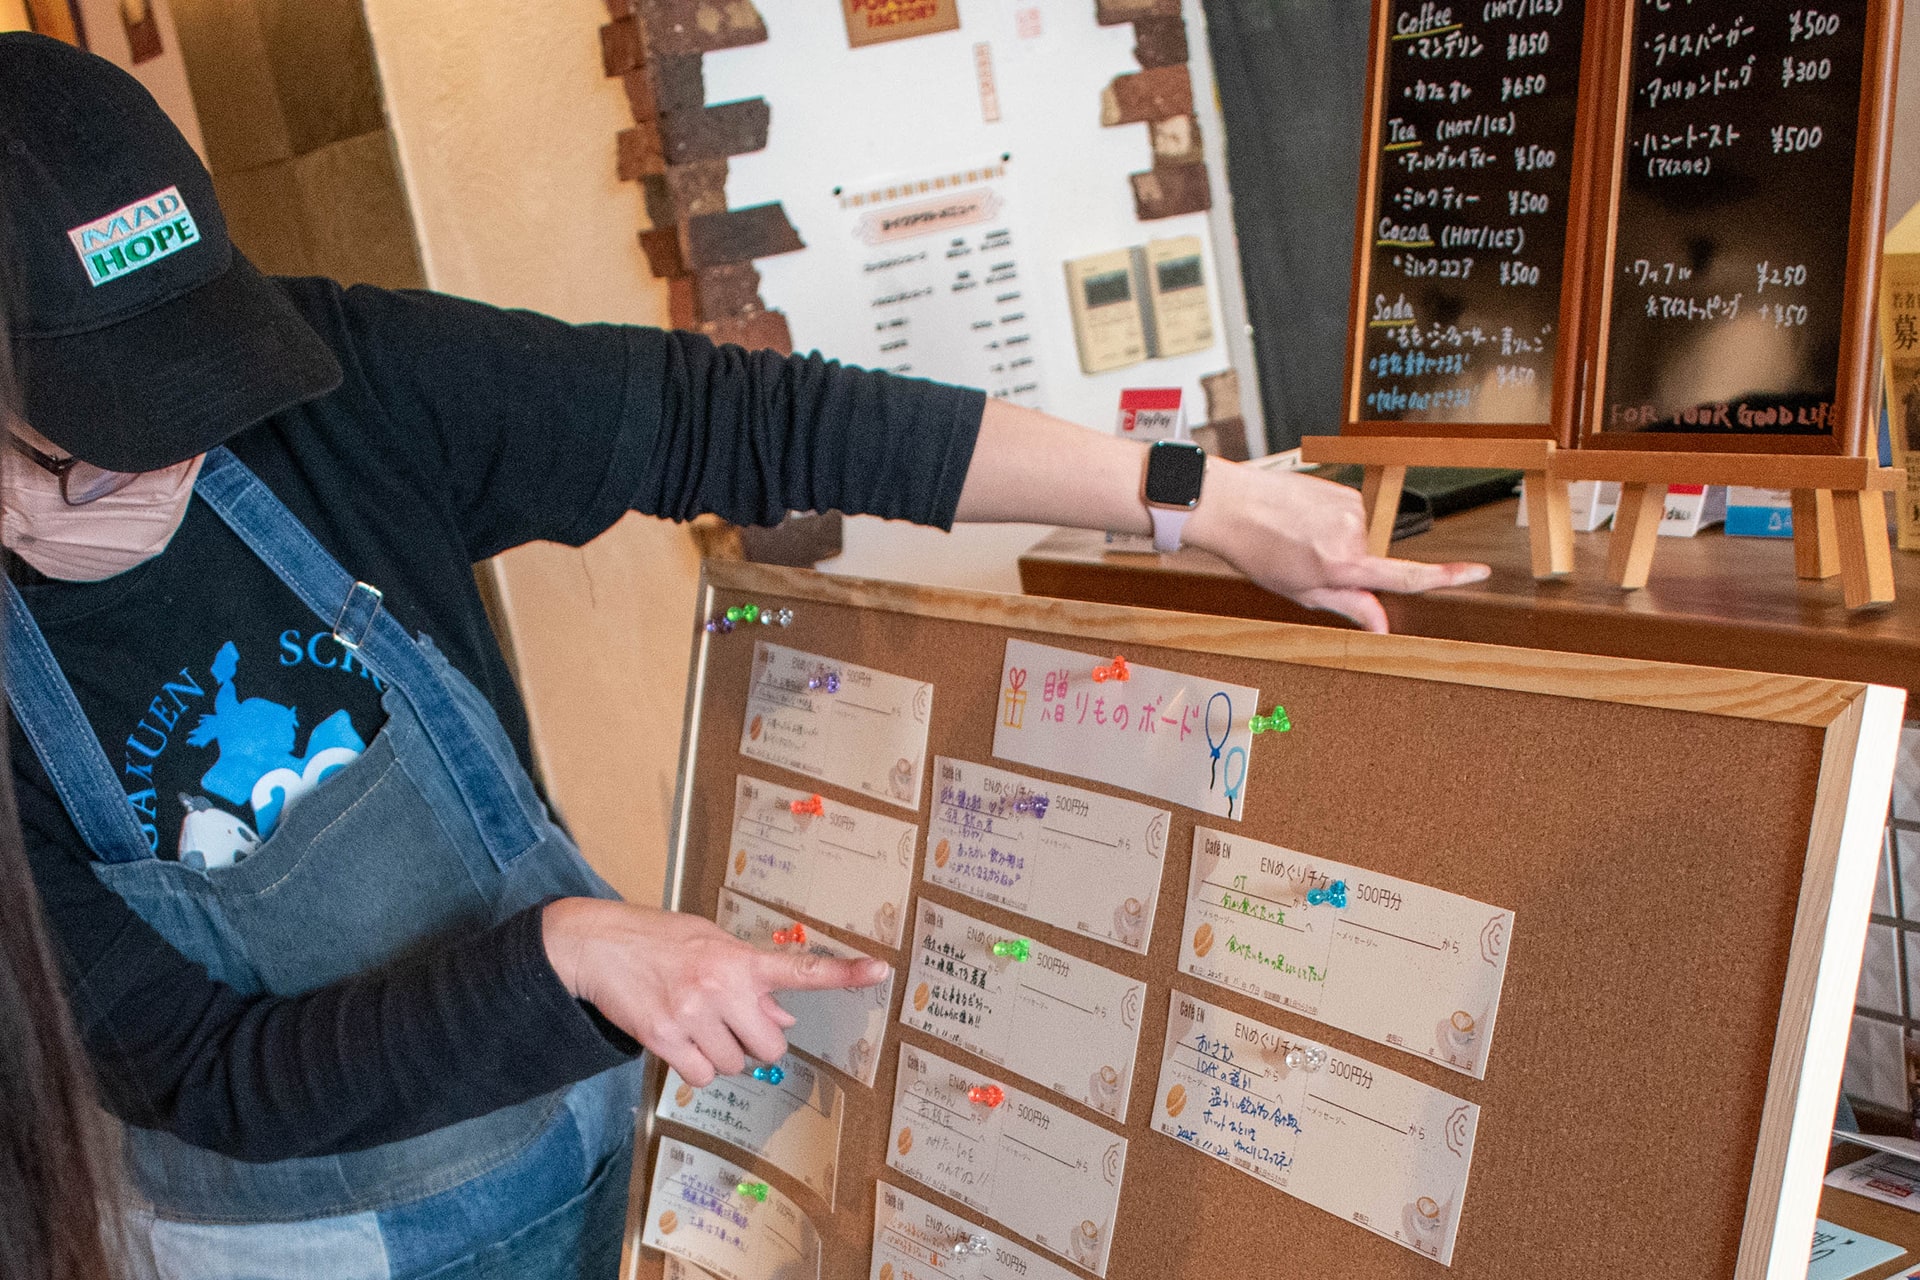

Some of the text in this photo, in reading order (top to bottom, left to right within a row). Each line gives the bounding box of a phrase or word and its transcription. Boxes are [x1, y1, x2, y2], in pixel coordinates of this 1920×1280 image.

[1397, 2, 1452, 34] Coffee
[1789, 10, 1840, 42] ¥500
[1506, 31, 1549, 61] ¥650
[1782, 57, 1832, 88] ¥300
[1501, 74, 1547, 102] ¥650
[1388, 117, 1417, 142] Tea
[1771, 125, 1822, 154] ¥500
[1514, 145, 1556, 171] ¥500
[1508, 190, 1549, 216] ¥500
[82, 193, 180, 250] MAD
[1378, 216, 1431, 241] Cocoa
[91, 216, 196, 278] HOPE
[1500, 261, 1540, 287] ¥500
[1756, 260, 1807, 293] ¥250
[1372, 293, 1415, 321] Soda
[1672, 403, 1733, 428] YOUR
[1738, 403, 1794, 426] GOOD
[1055, 795, 1089, 817] 500円分
[1222, 842, 1232, 859] EN
[1357, 883, 1403, 912] 500円分
[1441, 939, 1460, 954] から
[1037, 952, 1070, 978] 500円分
[1196, 1006, 1205, 1023] EN
[1329, 1058, 1374, 1089] 500円分
[1017, 1104, 1050, 1131] 500円分
[1408, 1122, 1426, 1140] から
[995, 1247, 1028, 1276] 500円分
